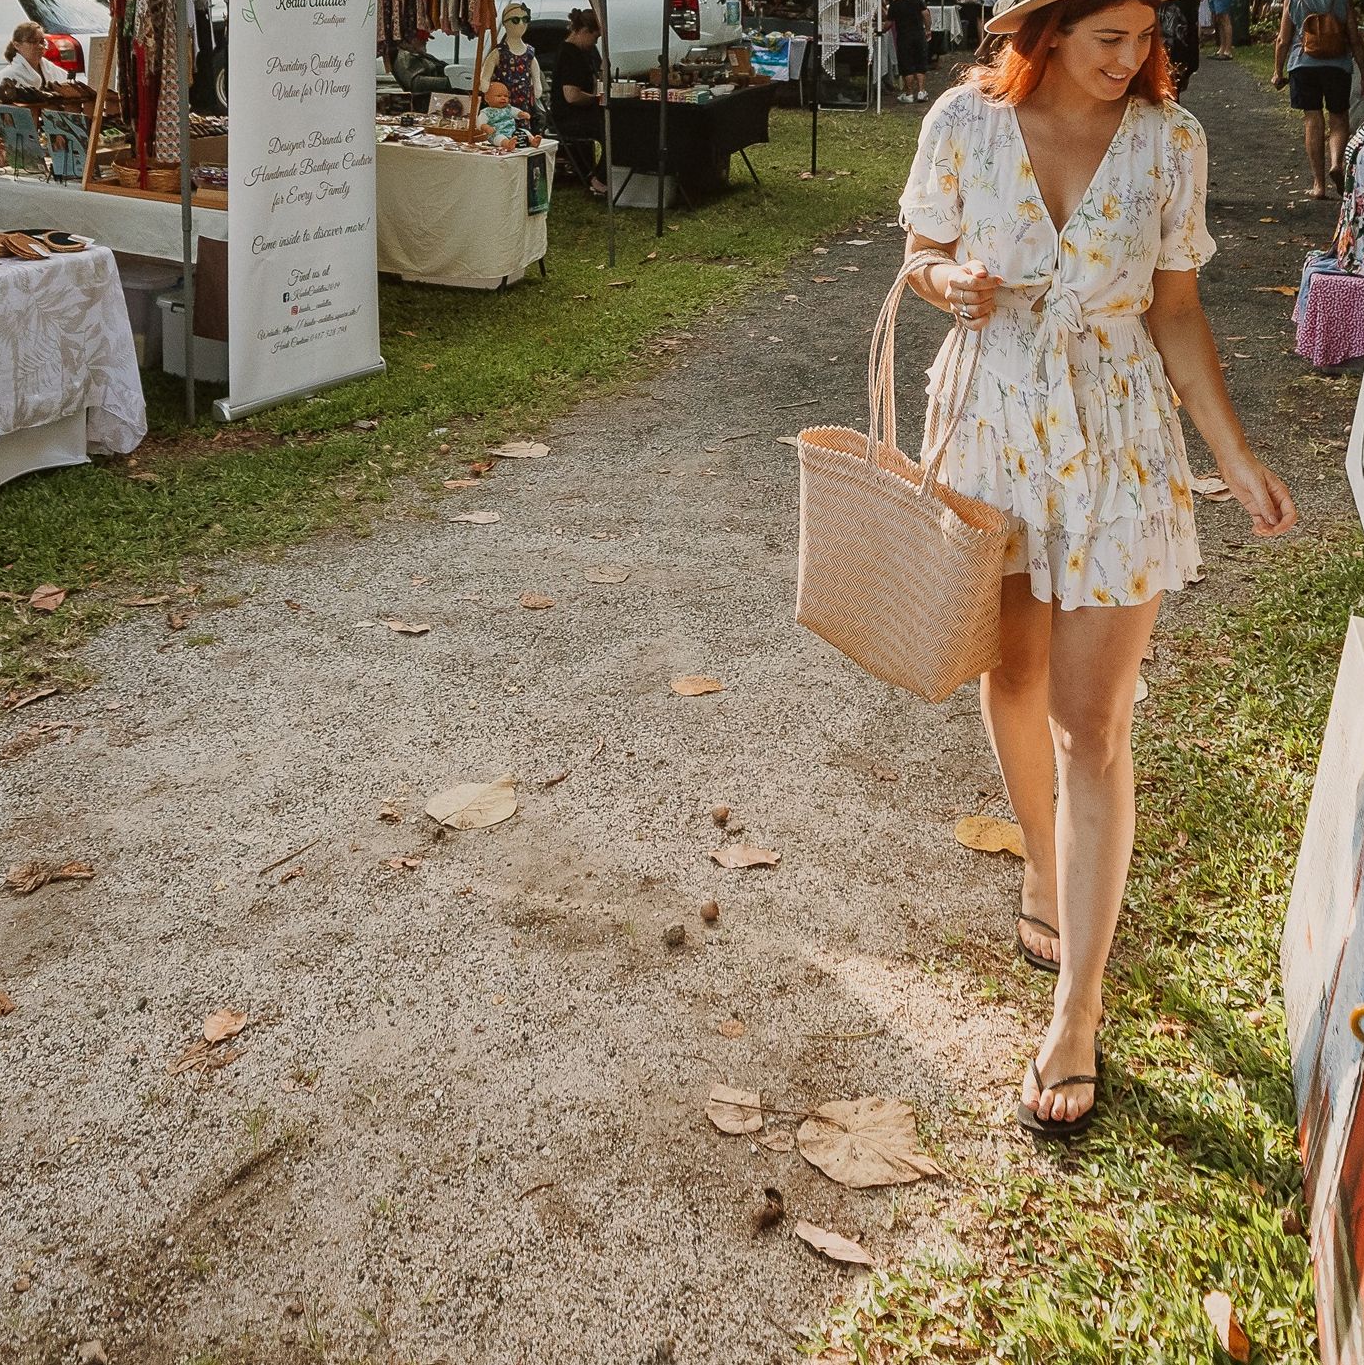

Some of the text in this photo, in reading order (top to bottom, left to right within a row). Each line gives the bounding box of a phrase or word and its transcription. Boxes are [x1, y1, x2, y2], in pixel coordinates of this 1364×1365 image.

[313, 13, 346, 27] Boutique
[266, 53, 355, 76] Providing Quality &
[272, 78, 351, 103] Value for Money
[268, 129, 355, 157] Designer Brands &
[244, 152, 373, 187] Handmade Boutique Couture
[271, 180, 351, 213] for Every Family
[252, 218, 371, 255] Come inside to discover more!
[288, 265, 330, 287] Find us at
